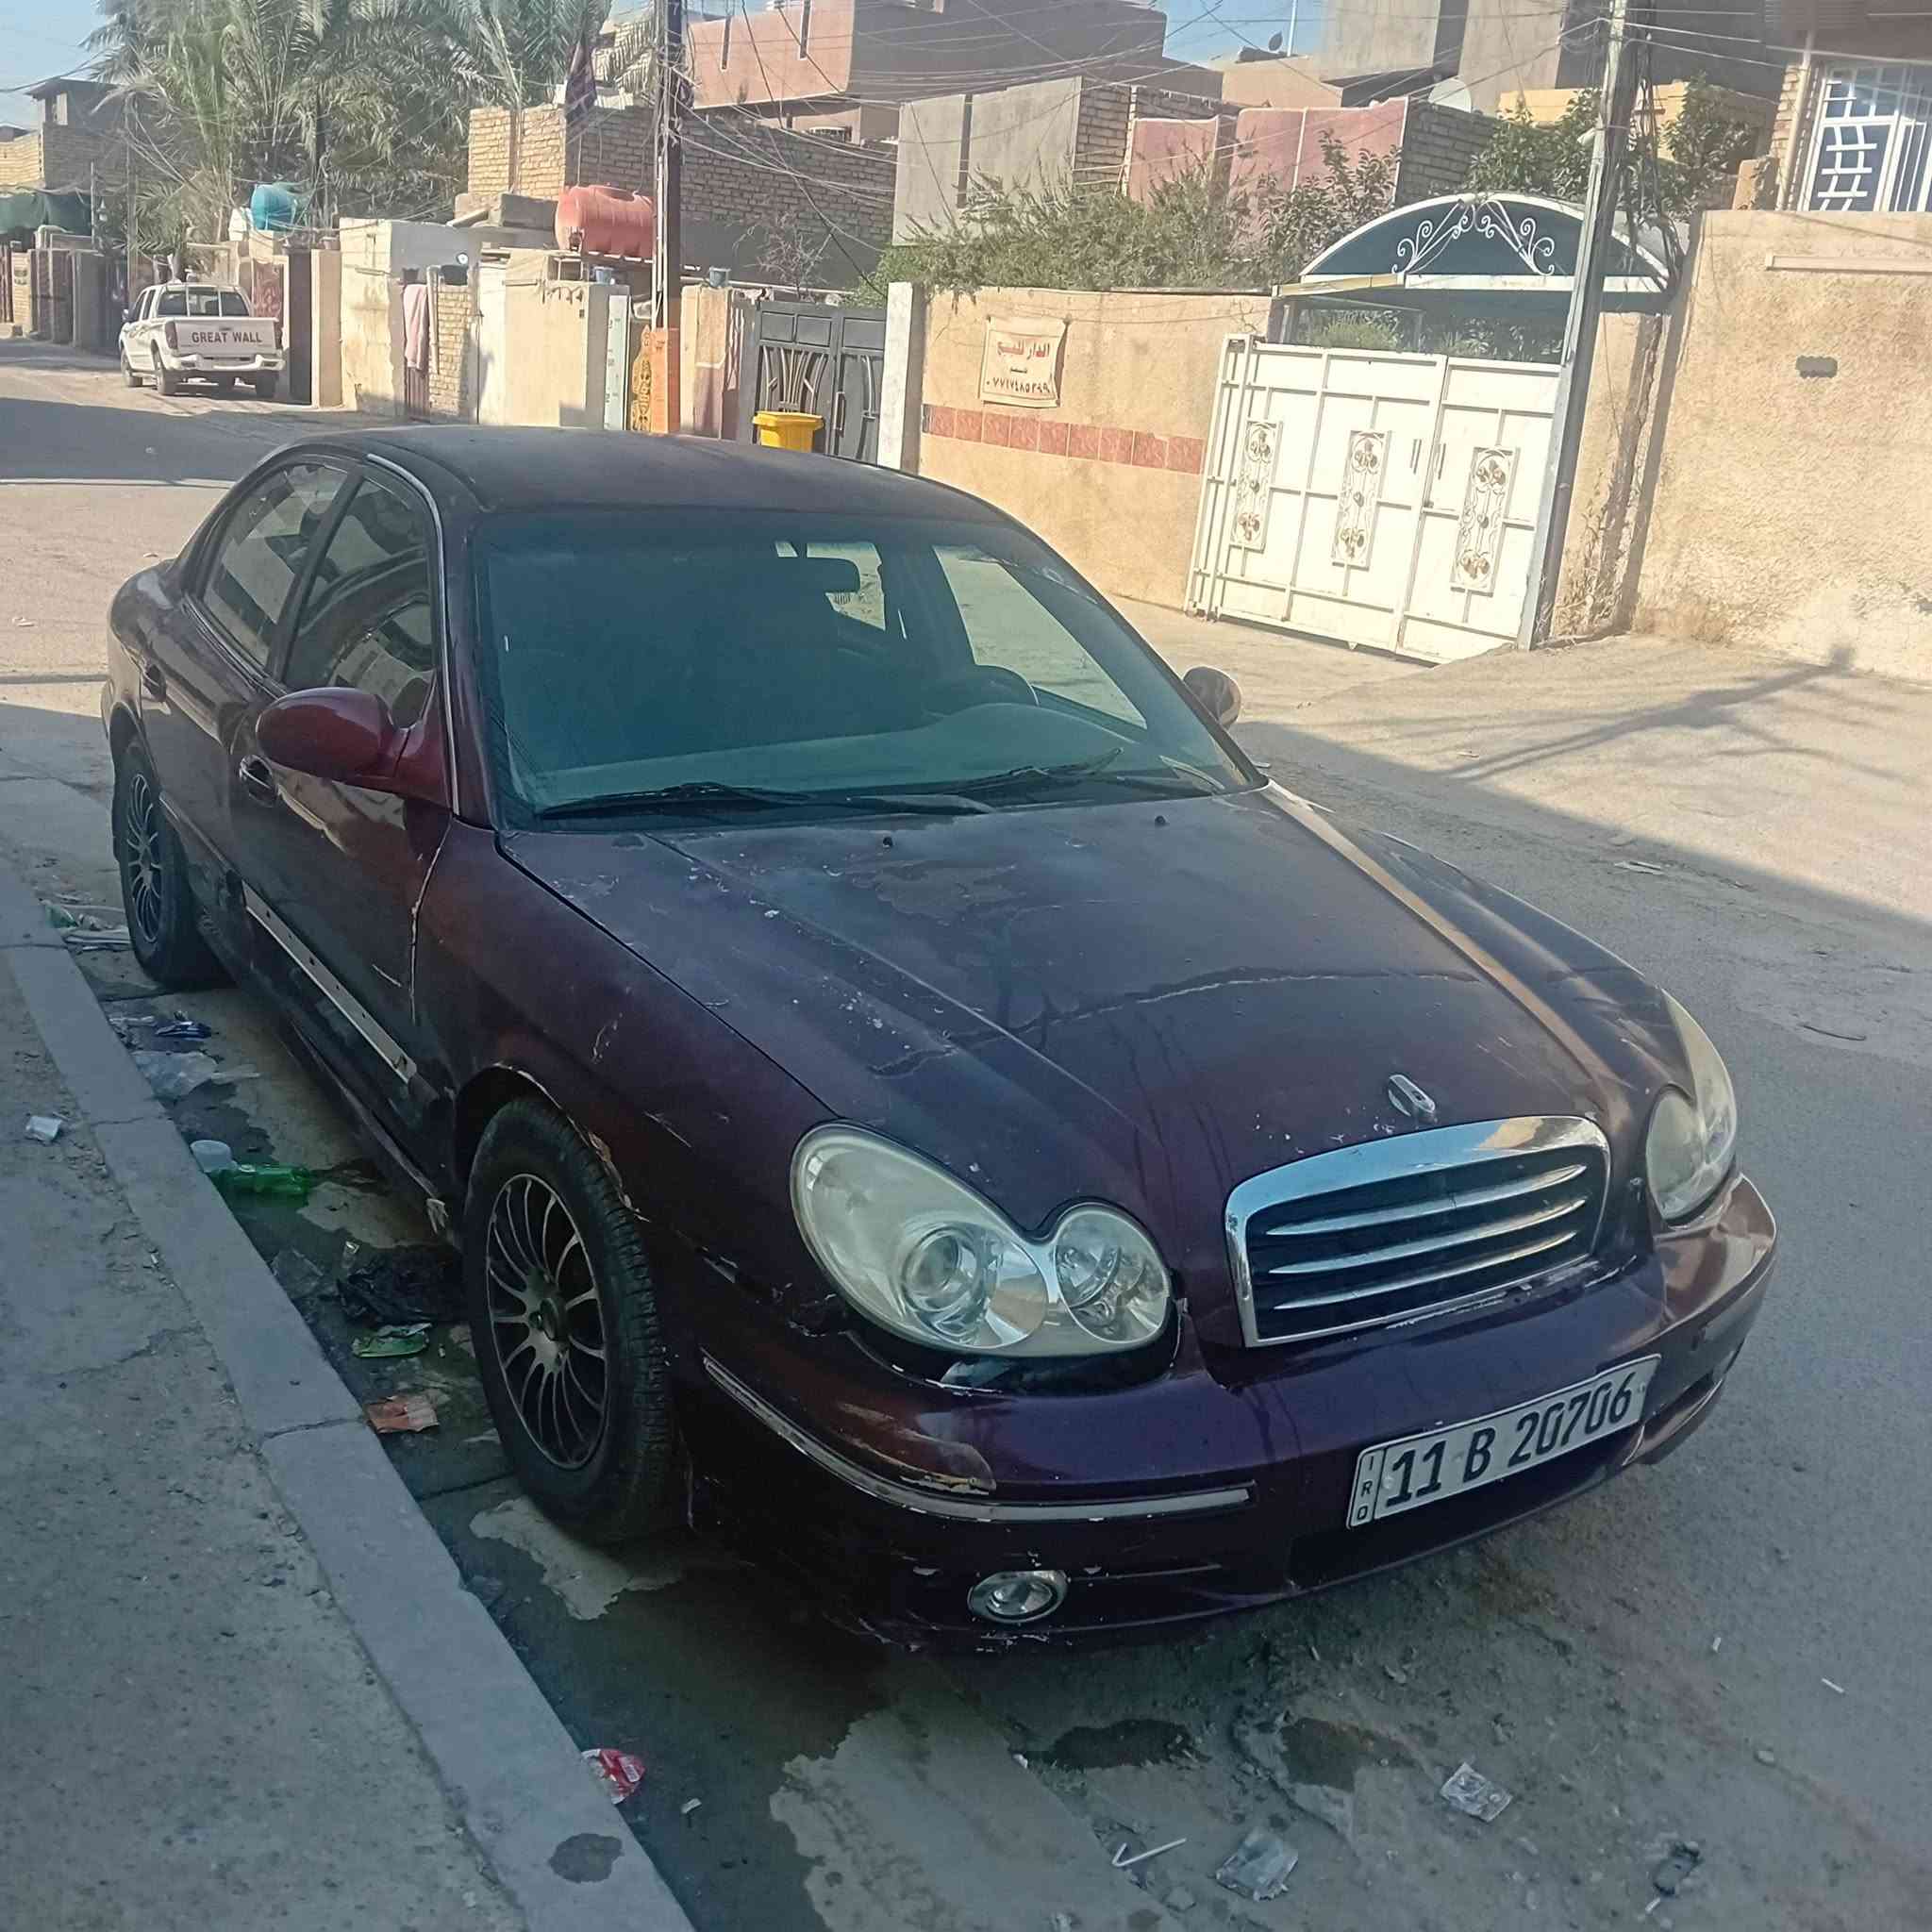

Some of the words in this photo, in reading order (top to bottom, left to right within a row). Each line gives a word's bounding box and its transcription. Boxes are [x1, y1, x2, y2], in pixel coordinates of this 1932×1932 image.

[192, 331, 228, 343] GREAT
[232, 332, 262, 343] WALL
[1386, 1441, 1447, 1507] 11
[1462, 1426, 1496, 1484] B
[1507, 1371, 1637, 1469] 20706
